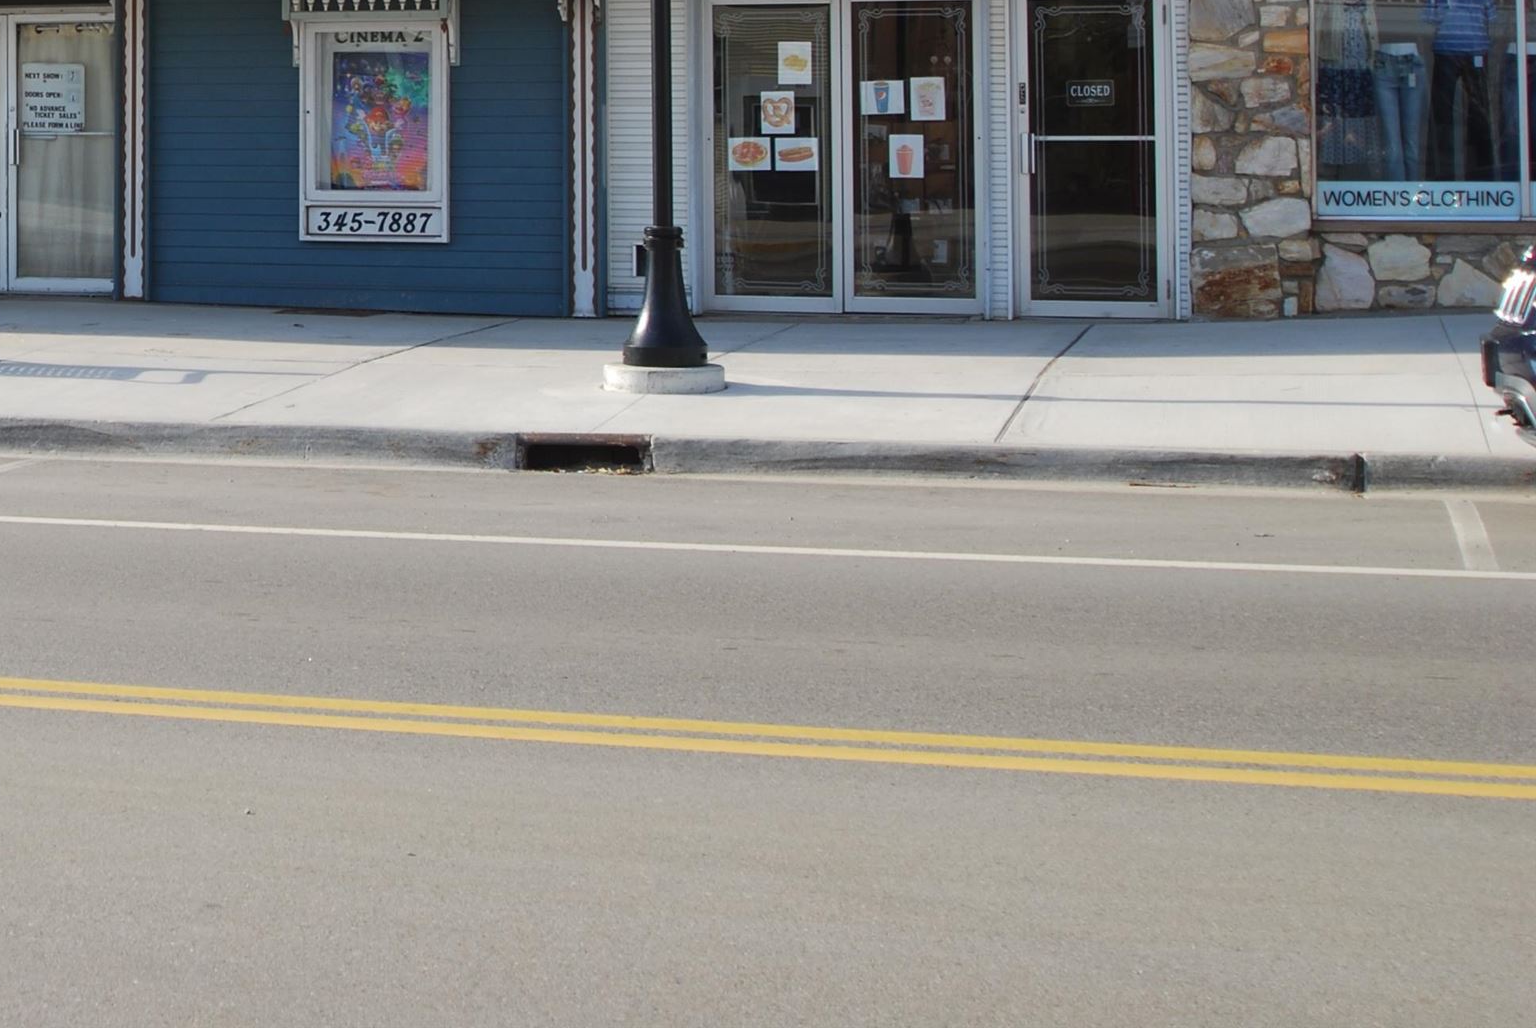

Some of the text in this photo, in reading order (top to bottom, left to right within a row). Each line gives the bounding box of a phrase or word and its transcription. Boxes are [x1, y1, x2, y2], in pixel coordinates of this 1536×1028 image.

[1070, 85, 1111, 97] CLOSED
[1323, 189, 1515, 207] WOMEN'S CLOTHING
[317, 211, 433, 233] 345-7887
